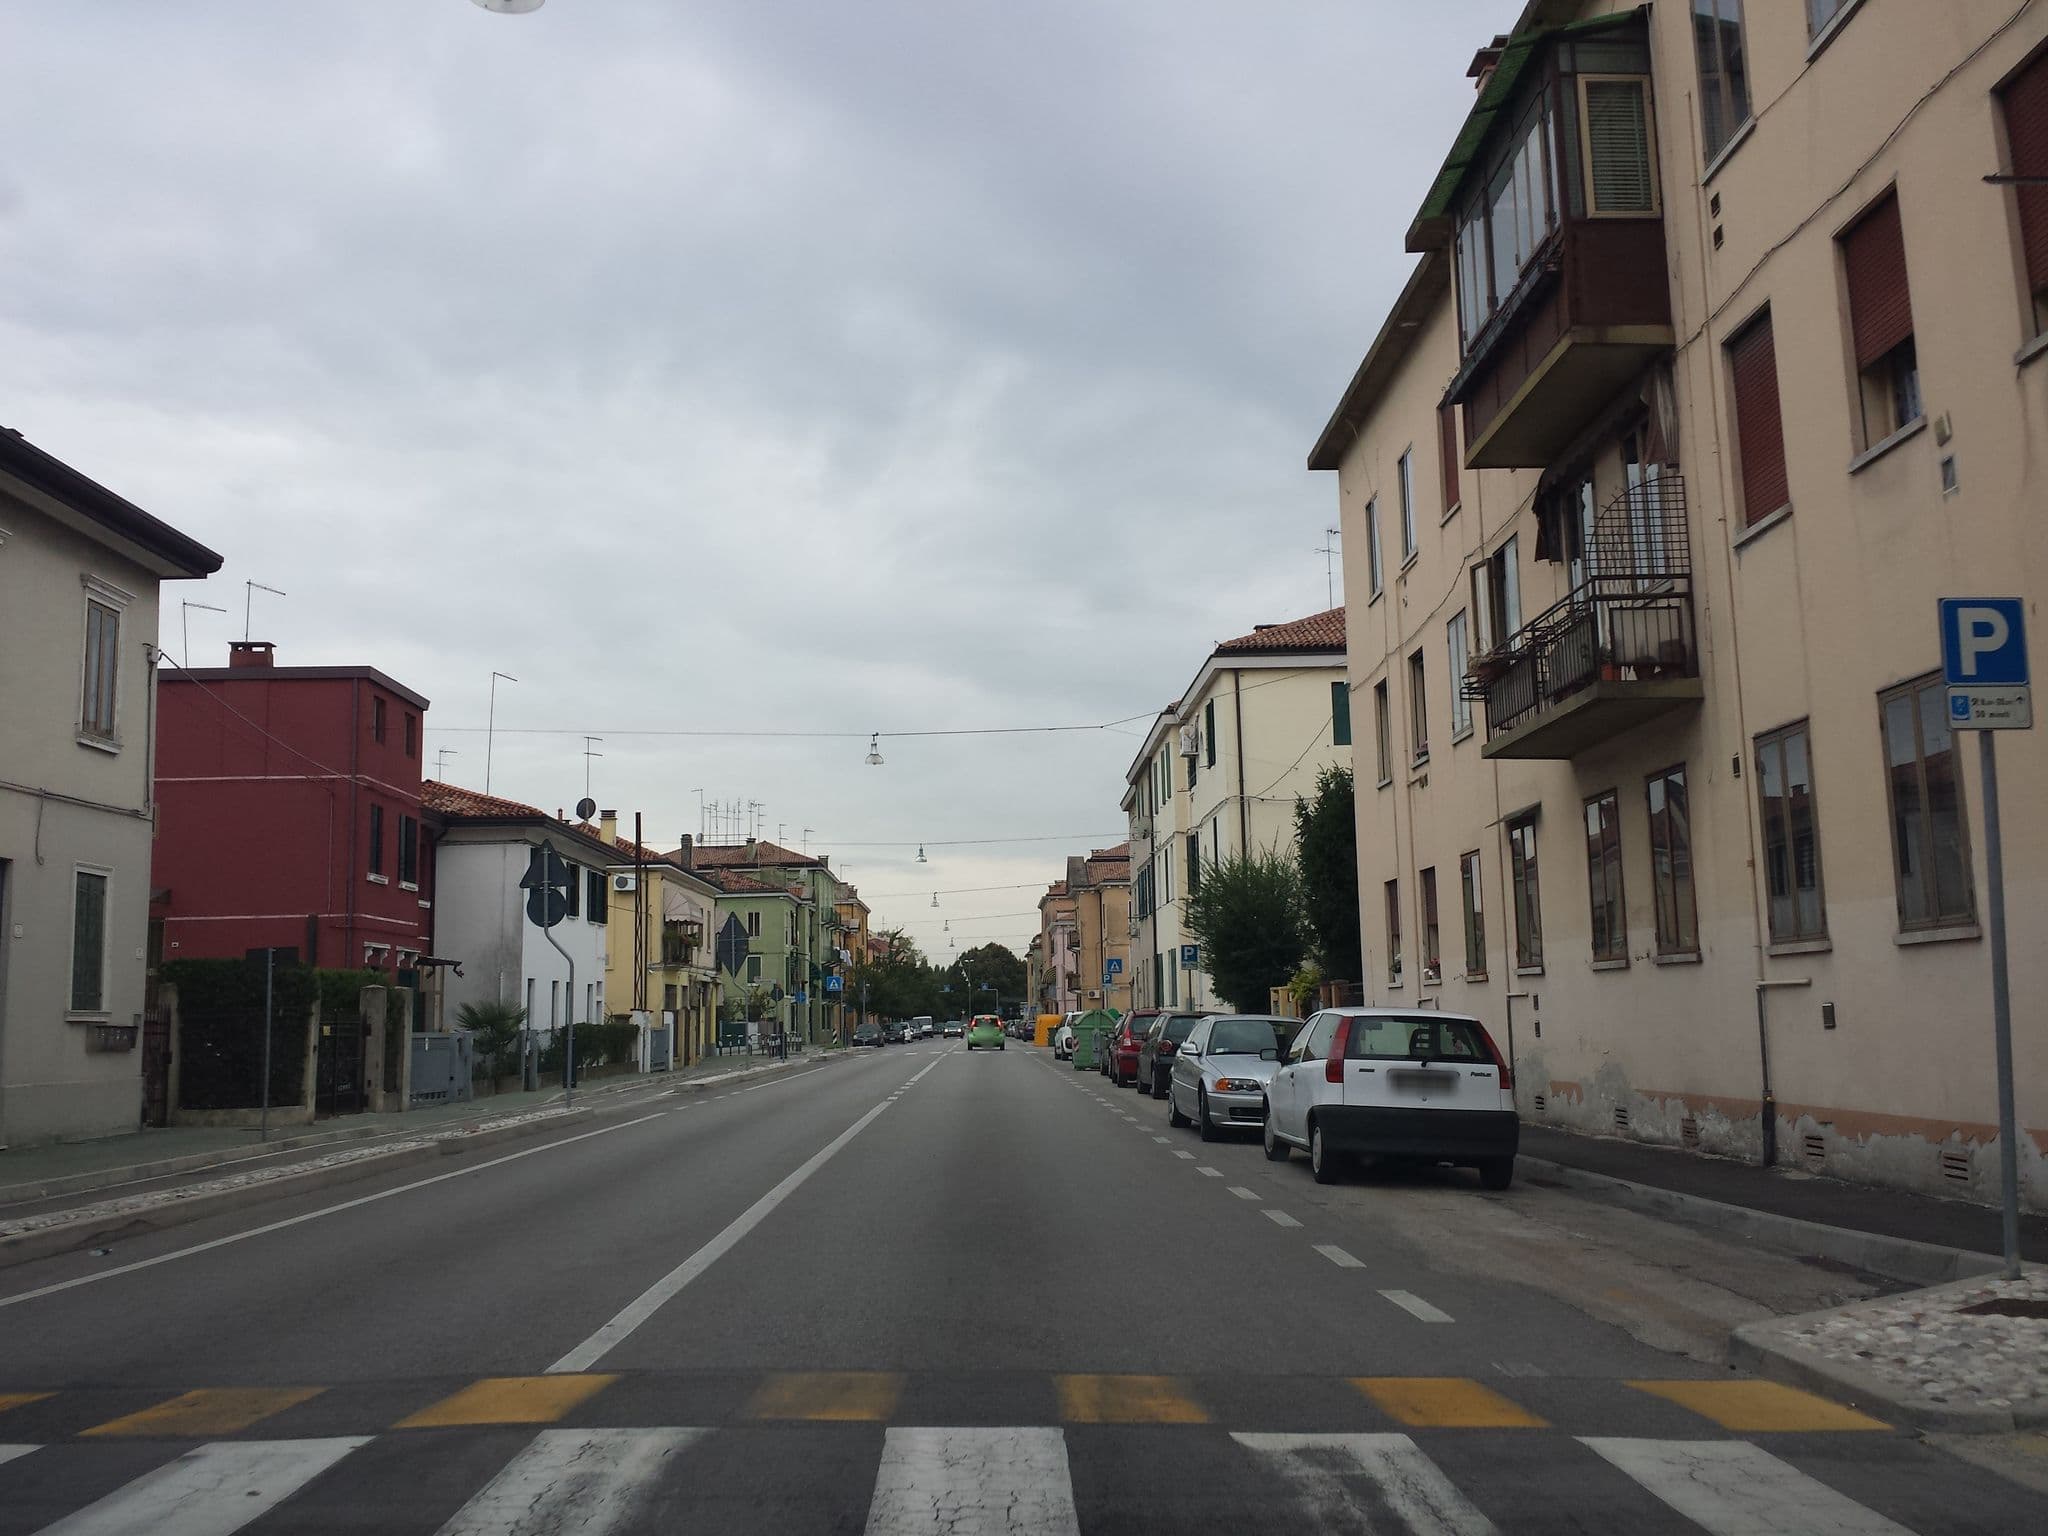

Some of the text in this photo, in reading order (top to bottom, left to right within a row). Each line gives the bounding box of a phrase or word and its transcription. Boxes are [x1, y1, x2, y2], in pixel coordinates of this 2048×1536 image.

[1957, 607, 2009, 676] P
[1184, 946, 1195, 960] P
[1103, 974, 1111, 983] P
